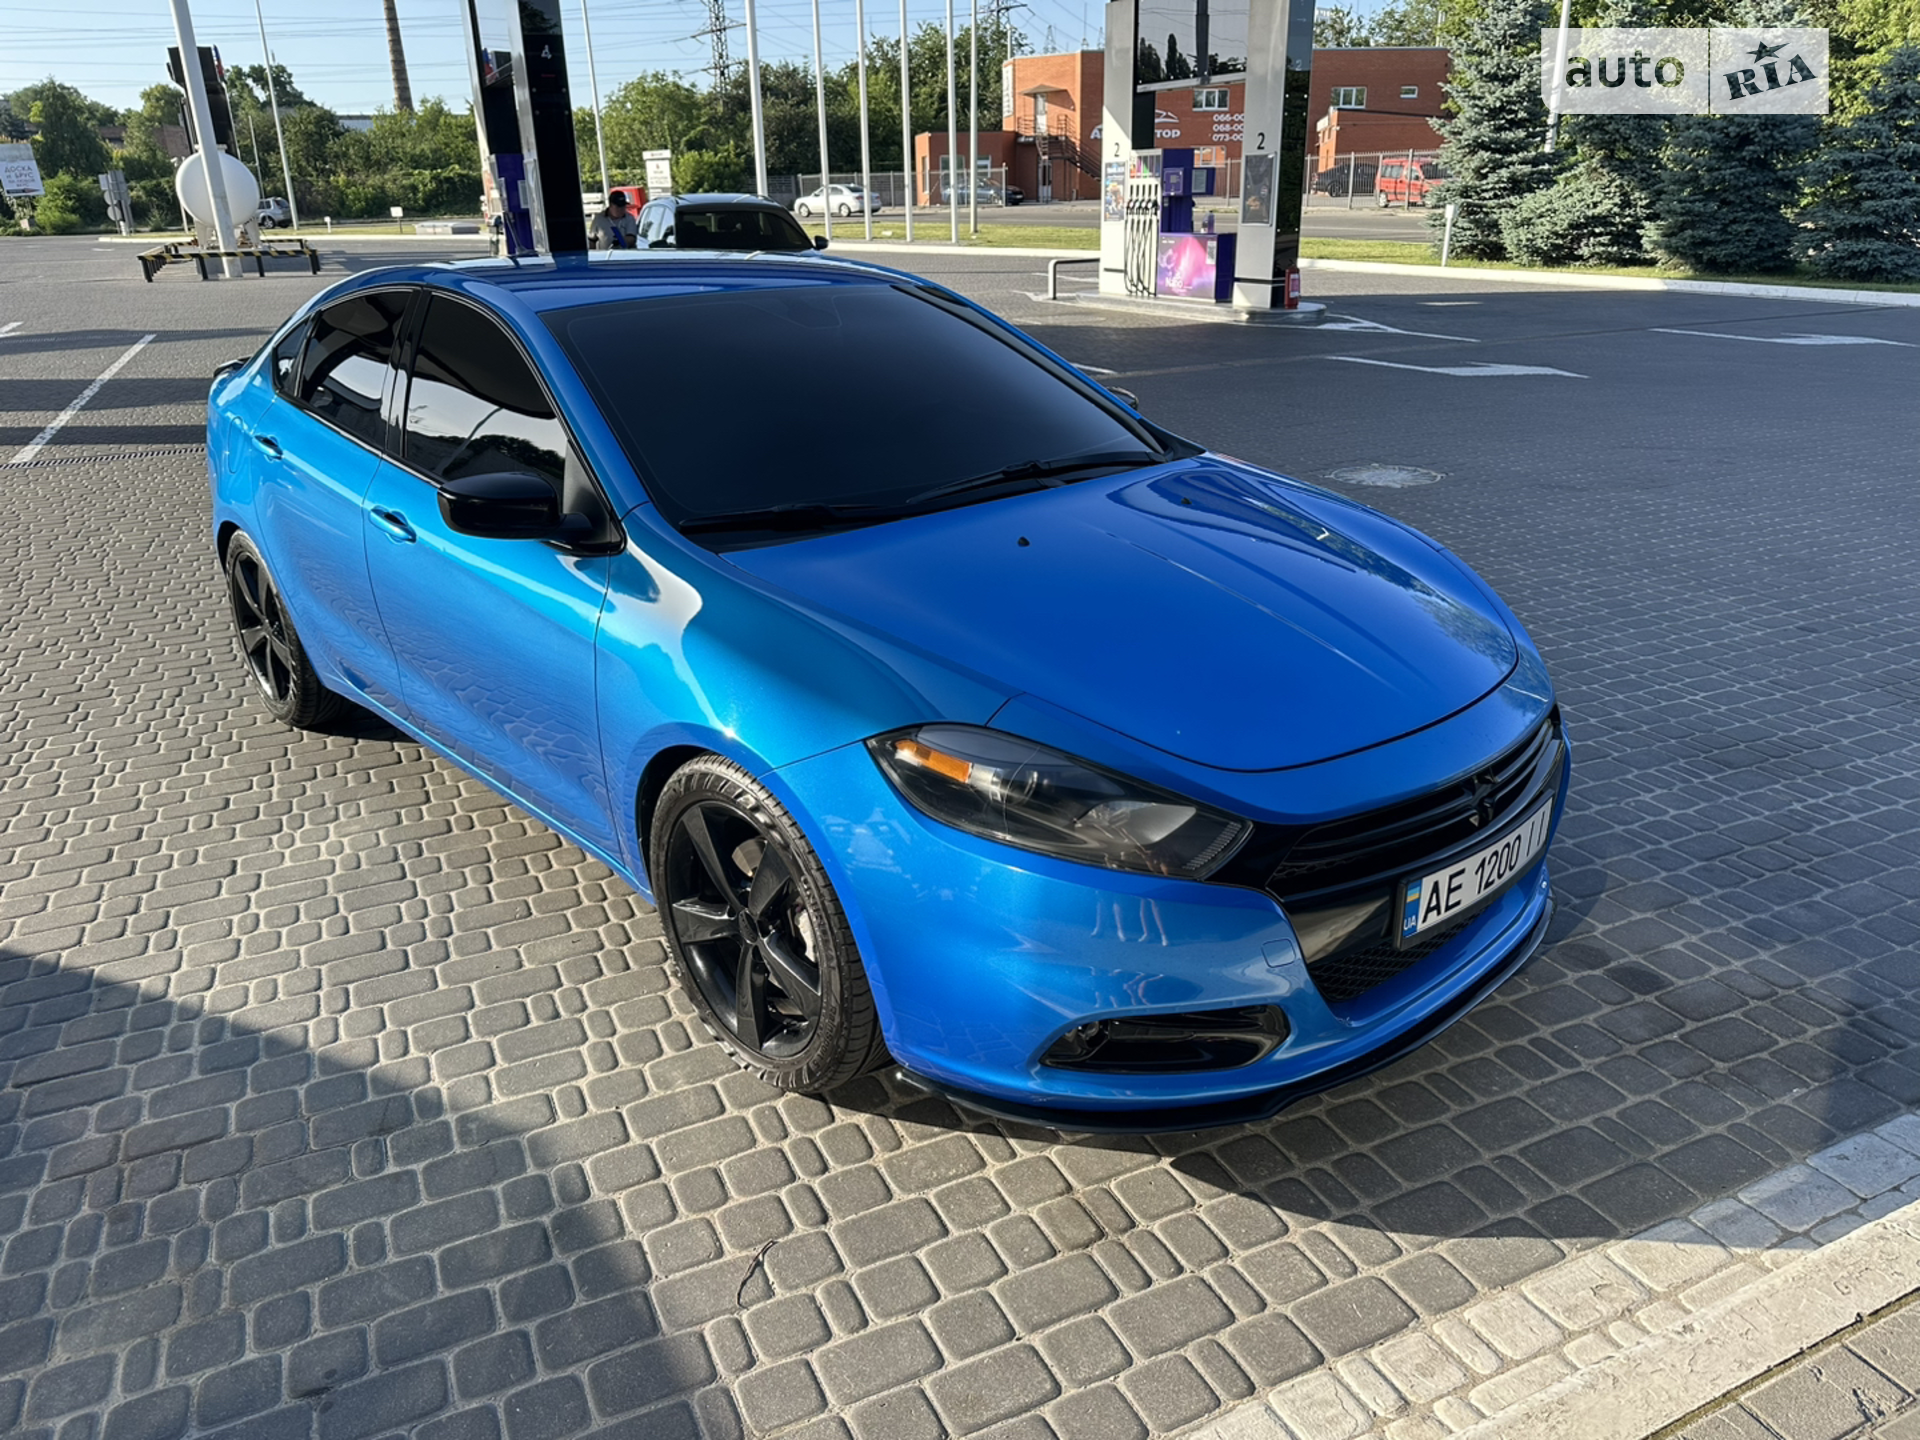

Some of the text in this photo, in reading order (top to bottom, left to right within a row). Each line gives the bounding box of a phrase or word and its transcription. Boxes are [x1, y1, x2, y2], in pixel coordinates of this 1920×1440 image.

[540, 44, 552, 60] 4
[1295, 59, 1302, 71] 2
[1257, 132, 1265, 150] 2
[1114, 142, 1120, 158] 2
[1422, 868, 1466, 924] AE
[1474, 834, 1522, 895] 1200
[1403, 914, 1416, 931] UA
